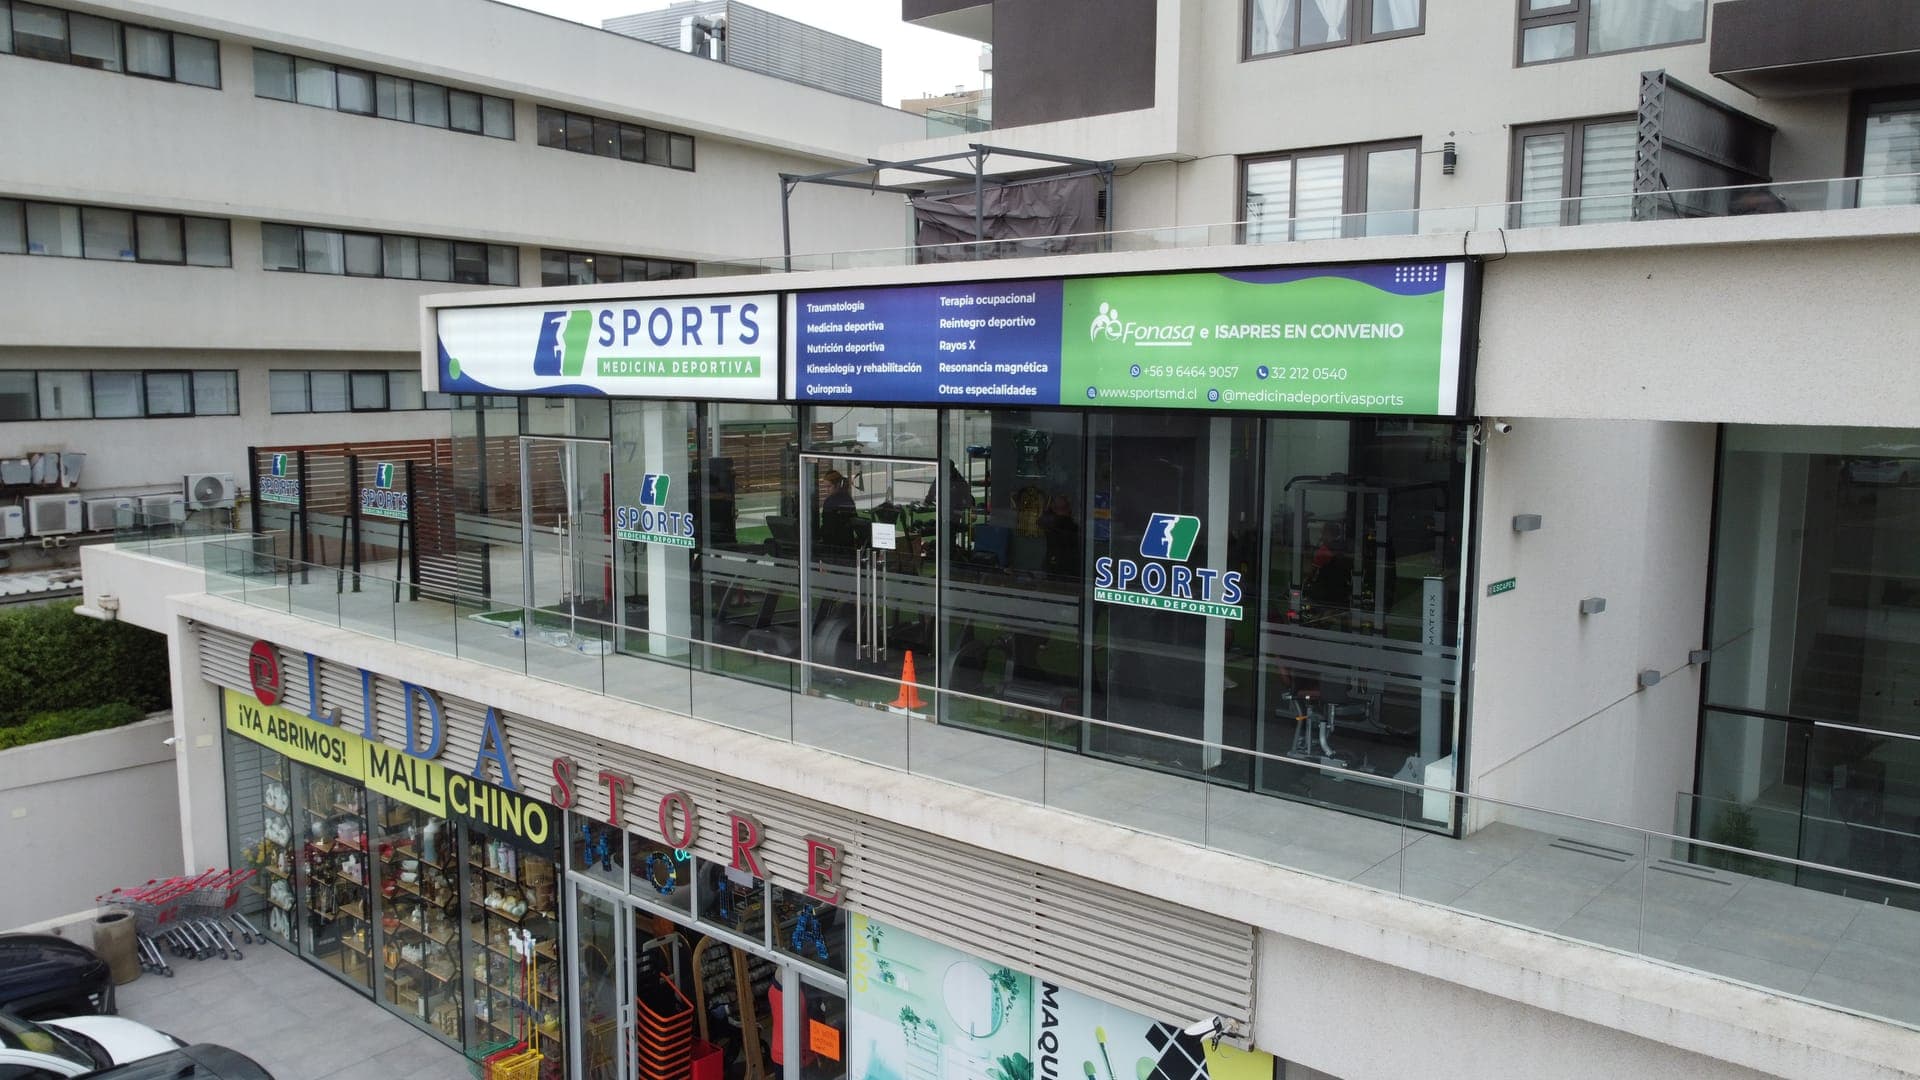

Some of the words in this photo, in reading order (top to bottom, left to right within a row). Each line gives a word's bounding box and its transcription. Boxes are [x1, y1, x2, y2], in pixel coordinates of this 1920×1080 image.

[807, 301, 865, 313] Traumatología
[940, 296, 974, 307] Terapia
[976, 293, 1035, 306] ocupacional
[598, 303, 760, 347] SPORTS
[807, 322, 843, 333] Medicina
[844, 321, 884, 333] deportiva
[940, 317, 986, 329] Reintegro
[988, 316, 1036, 329] deportivo
[1122, 322, 1195, 344] Fonasa
[1200, 328, 1209, 339] e
[1215, 325, 1280, 339] ISAPRES
[1285, 324, 1307, 339] EN
[1311, 323, 1404, 339] CONVENIO
[807, 343, 844, 354] Nutrición
[845, 342, 885, 354] deportiva
[940, 340, 967, 352] Rayos
[969, 340, 976, 350] X
[603, 361, 665, 375] MEDICINA
[672, 360, 753, 374] DEPORTIVA
[807, 364, 855, 375] Kinesiología
[856, 366, 863, 375] y
[864, 363, 922, 374] rehabilitación
[939, 363, 993, 373] Resonancia
[995, 361, 1048, 375] magnética
[1142, 367, 1163, 378] +56
[1165, 367, 1174, 378] 9
[1176, 366, 1206, 378] 6464
[1209, 367, 1239, 379] 9057
[1271, 367, 1287, 380] 32
[1289, 367, 1310, 380] 212
[1312, 368, 1347, 380] 0540
[807, 385, 852, 395] Quiropraxia
[939, 385, 963, 395] Otras
[965, 385, 1038, 396] especialidades
[1099, 387, 1197, 401] www.sportsmd.cl
[1222, 389, 1404, 407] @medicinadeportivasports
[259, 476, 299, 497] SPORTS
[361, 488, 408, 511] SPORTS
[617, 506, 695, 537] SPORTS
[619, 531, 651, 542] MEDICINA
[653, 534, 692, 547] DEPORTIVA
[1095, 556, 1242, 605] SPORTS
[1097, 591, 1157, 607] MEDICINA
[1164, 599, 1238, 618] DEPORTIVA
[1428, 594, 1437, 645] MATRIX
[239, 703, 264, 733] ¡YA
[267, 718, 347, 766] ABRIMOS!
[370, 744, 441, 803] MALL
[449, 774, 548, 845] CHINO
[550, 756, 847, 906] STORE
